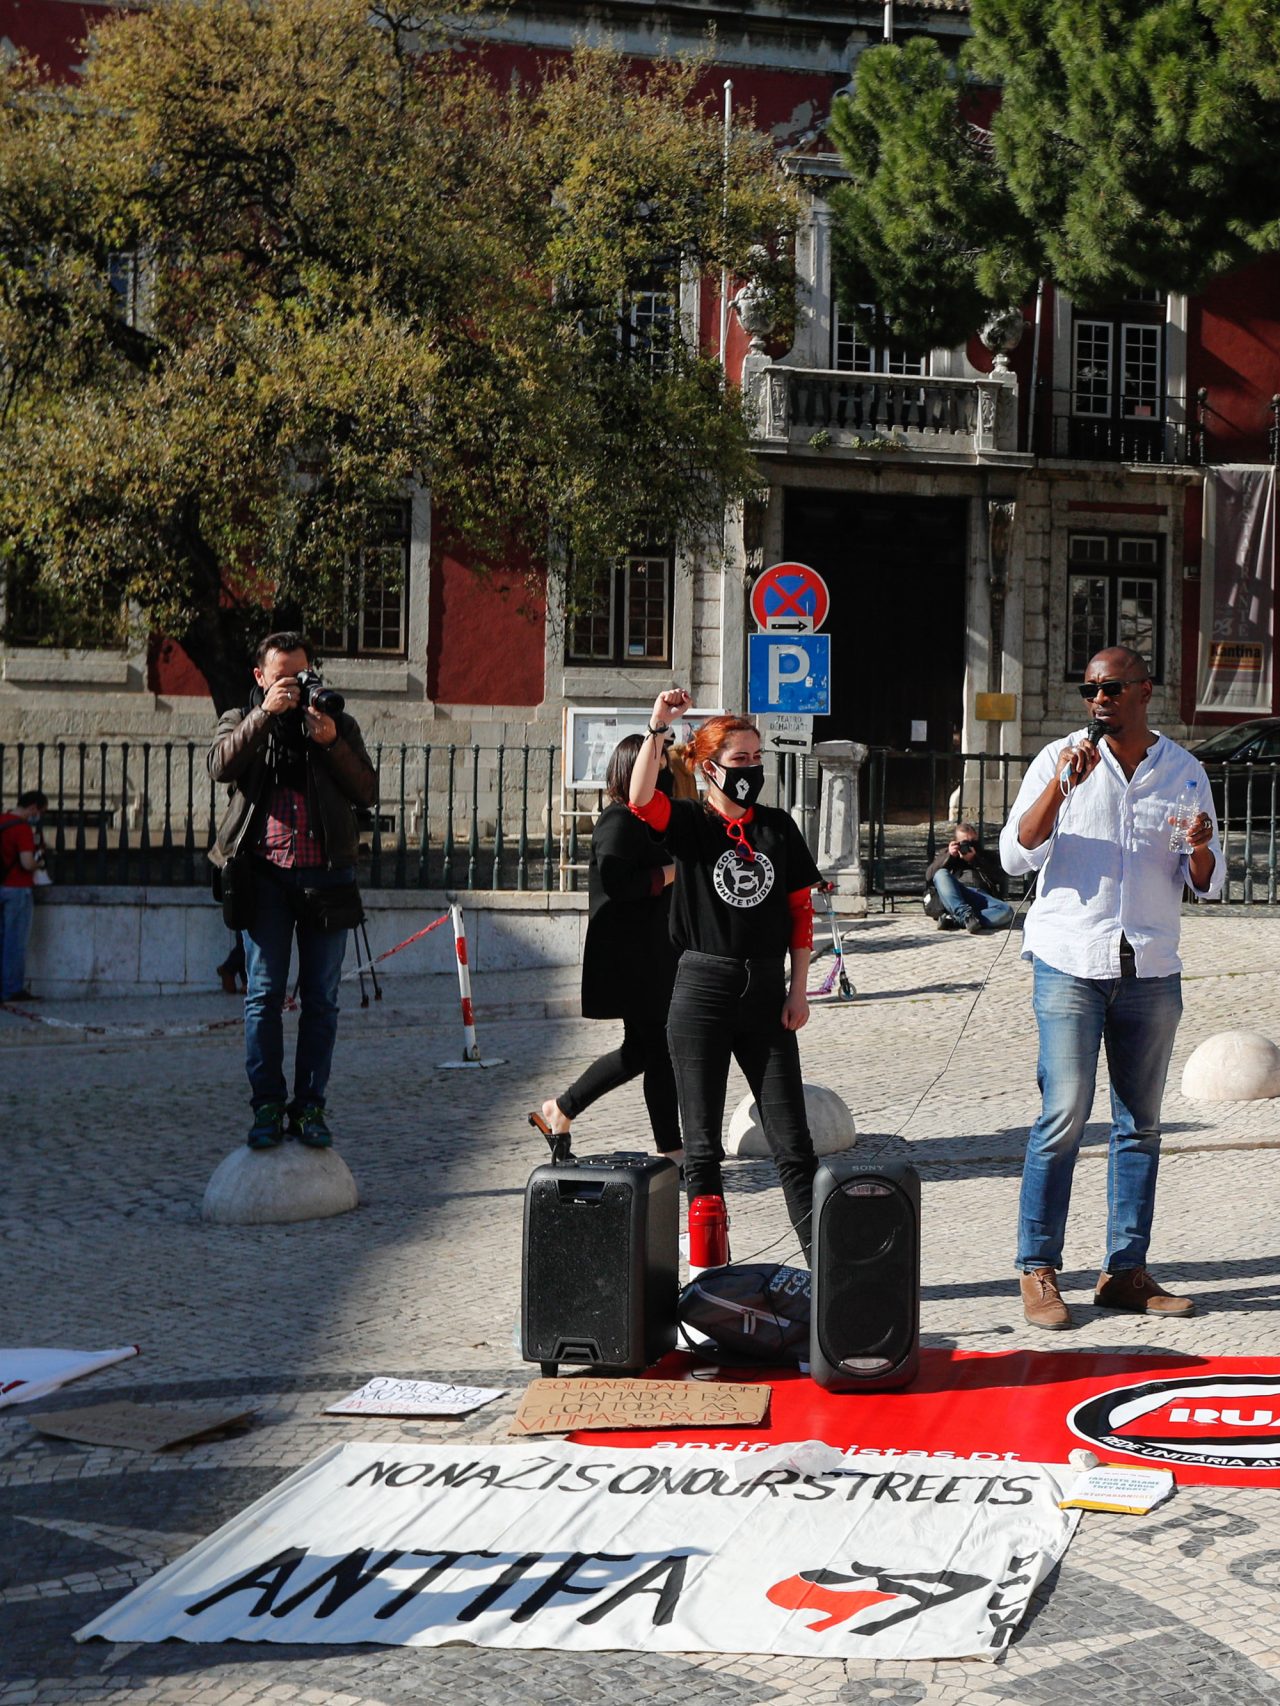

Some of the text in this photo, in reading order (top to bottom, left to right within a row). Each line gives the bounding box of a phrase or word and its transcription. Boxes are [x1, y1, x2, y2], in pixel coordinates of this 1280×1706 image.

[768, 644, 810, 704] P
[716, 851, 773, 873] GOO GHT
[716, 880, 771, 906] WHITE PRIDE
[369, 1379, 482, 1398] O RACISMO
[537, 1381, 760, 1394] SOLIDARIEDADE COM
[561, 1391, 737, 1402] MAMADOU BA
[522, 1401, 737, 1418] E COM TODAS AS
[659, 1411, 759, 1422] RACISMO
[1098, 1435, 1146, 1451] REDE
[1141, 1446, 1246, 1467] UNITÁRIA
[346, 1461, 434, 1489] NO
[427, 1456, 613, 1492] NAZIS
[607, 1465, 688, 1495] ON
[793, 1472, 1041, 1506] STREETS
[184, 1547, 689, 1625] ANTIFA
